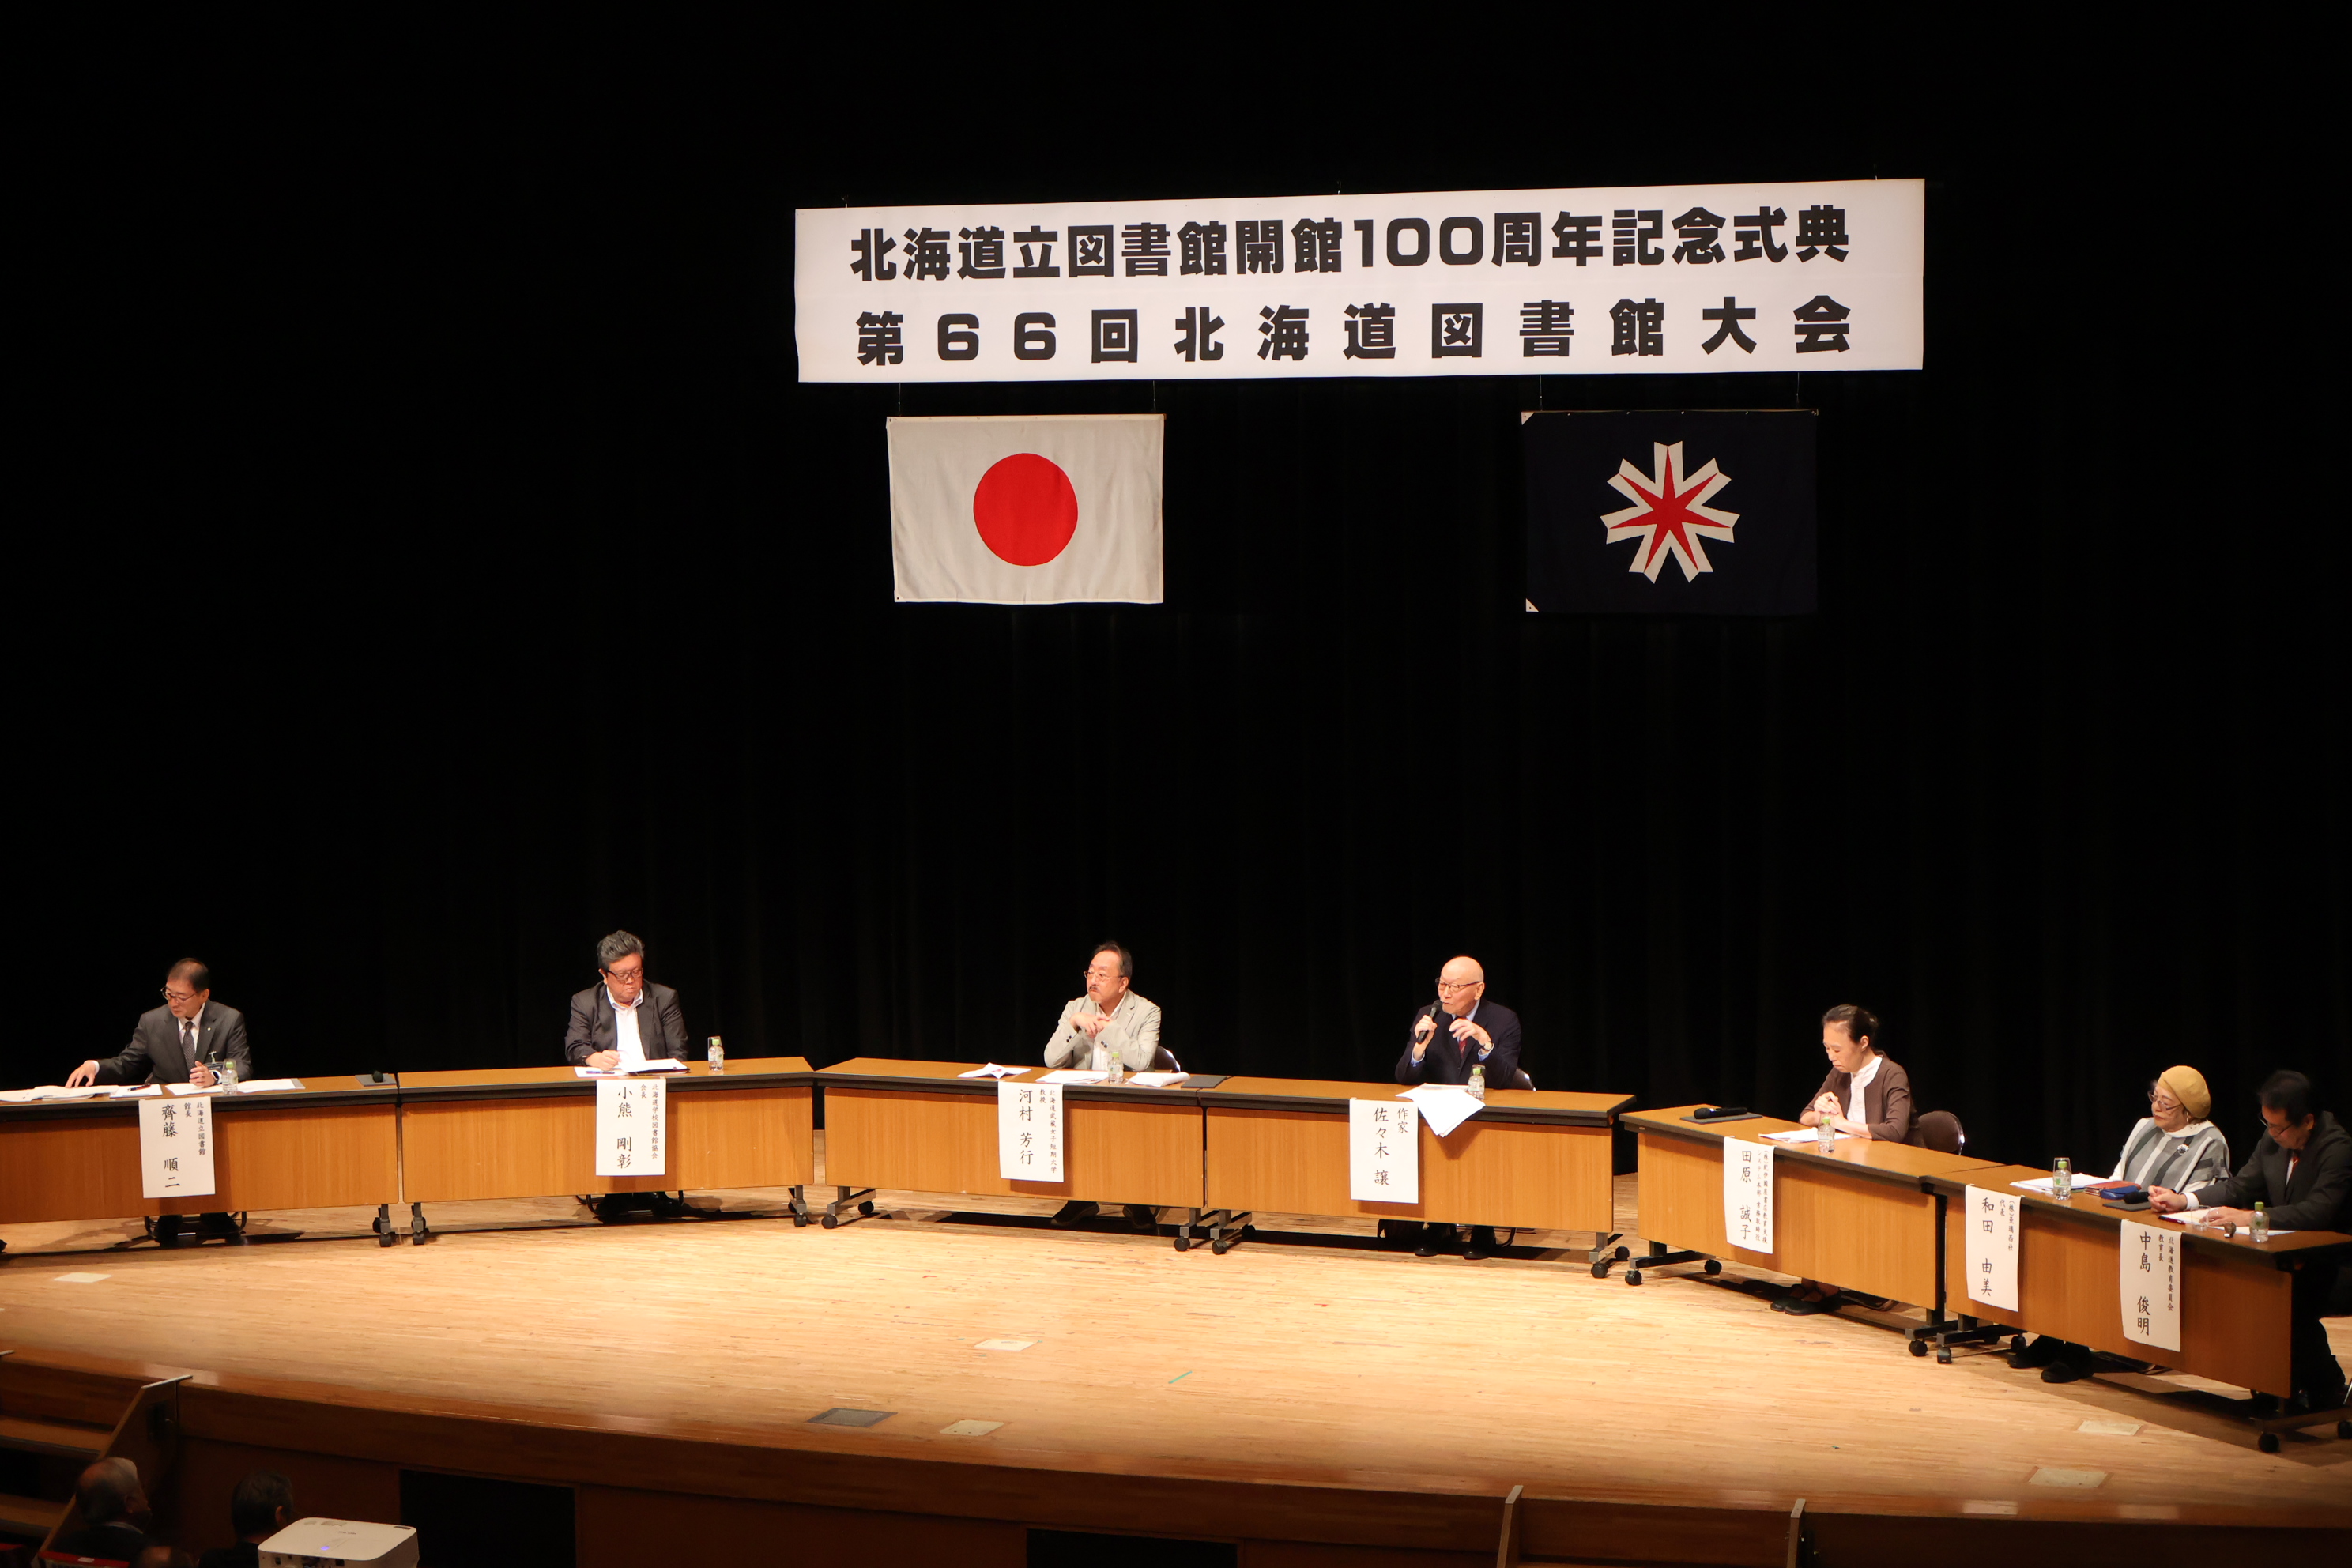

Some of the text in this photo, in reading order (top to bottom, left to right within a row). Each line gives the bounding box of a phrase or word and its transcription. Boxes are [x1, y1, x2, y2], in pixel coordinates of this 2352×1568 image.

[850, 205, 1849, 282] 北海道立図書館開館100周年記念式典
[856, 295, 1852, 367] 第66回北海道図書館大会
[183, 1102, 193, 1118] 館長
[640, 1084, 647, 1099] 会長
[650, 1084, 659, 1159] 北海道学校図書館協会
[1018, 1089, 1035, 1166] 河村 芳行
[1039, 1089, 1046, 1104] 教授
[1396, 1108, 1409, 1134] 作家
[196, 1102, 206, 1156] 北海道立図書館
[616, 1087, 633, 1170] 小熊 剛彰
[1049, 1090, 1057, 1174] 北海道武蔵女子短期大学
[1373, 1107, 1390, 1159] 佐々木
[163, 1157, 181, 1189] 順二
[1740, 1151, 1752, 1241] 田原 誠子
[2000, 1199, 2006, 1217] 代表
[1980, 1197, 1995, 1297] 和田 由美
[2136, 1231, 2152, 1336] 中島 俊明
[2166, 1237, 2175, 1312] 北海道教育委員会
